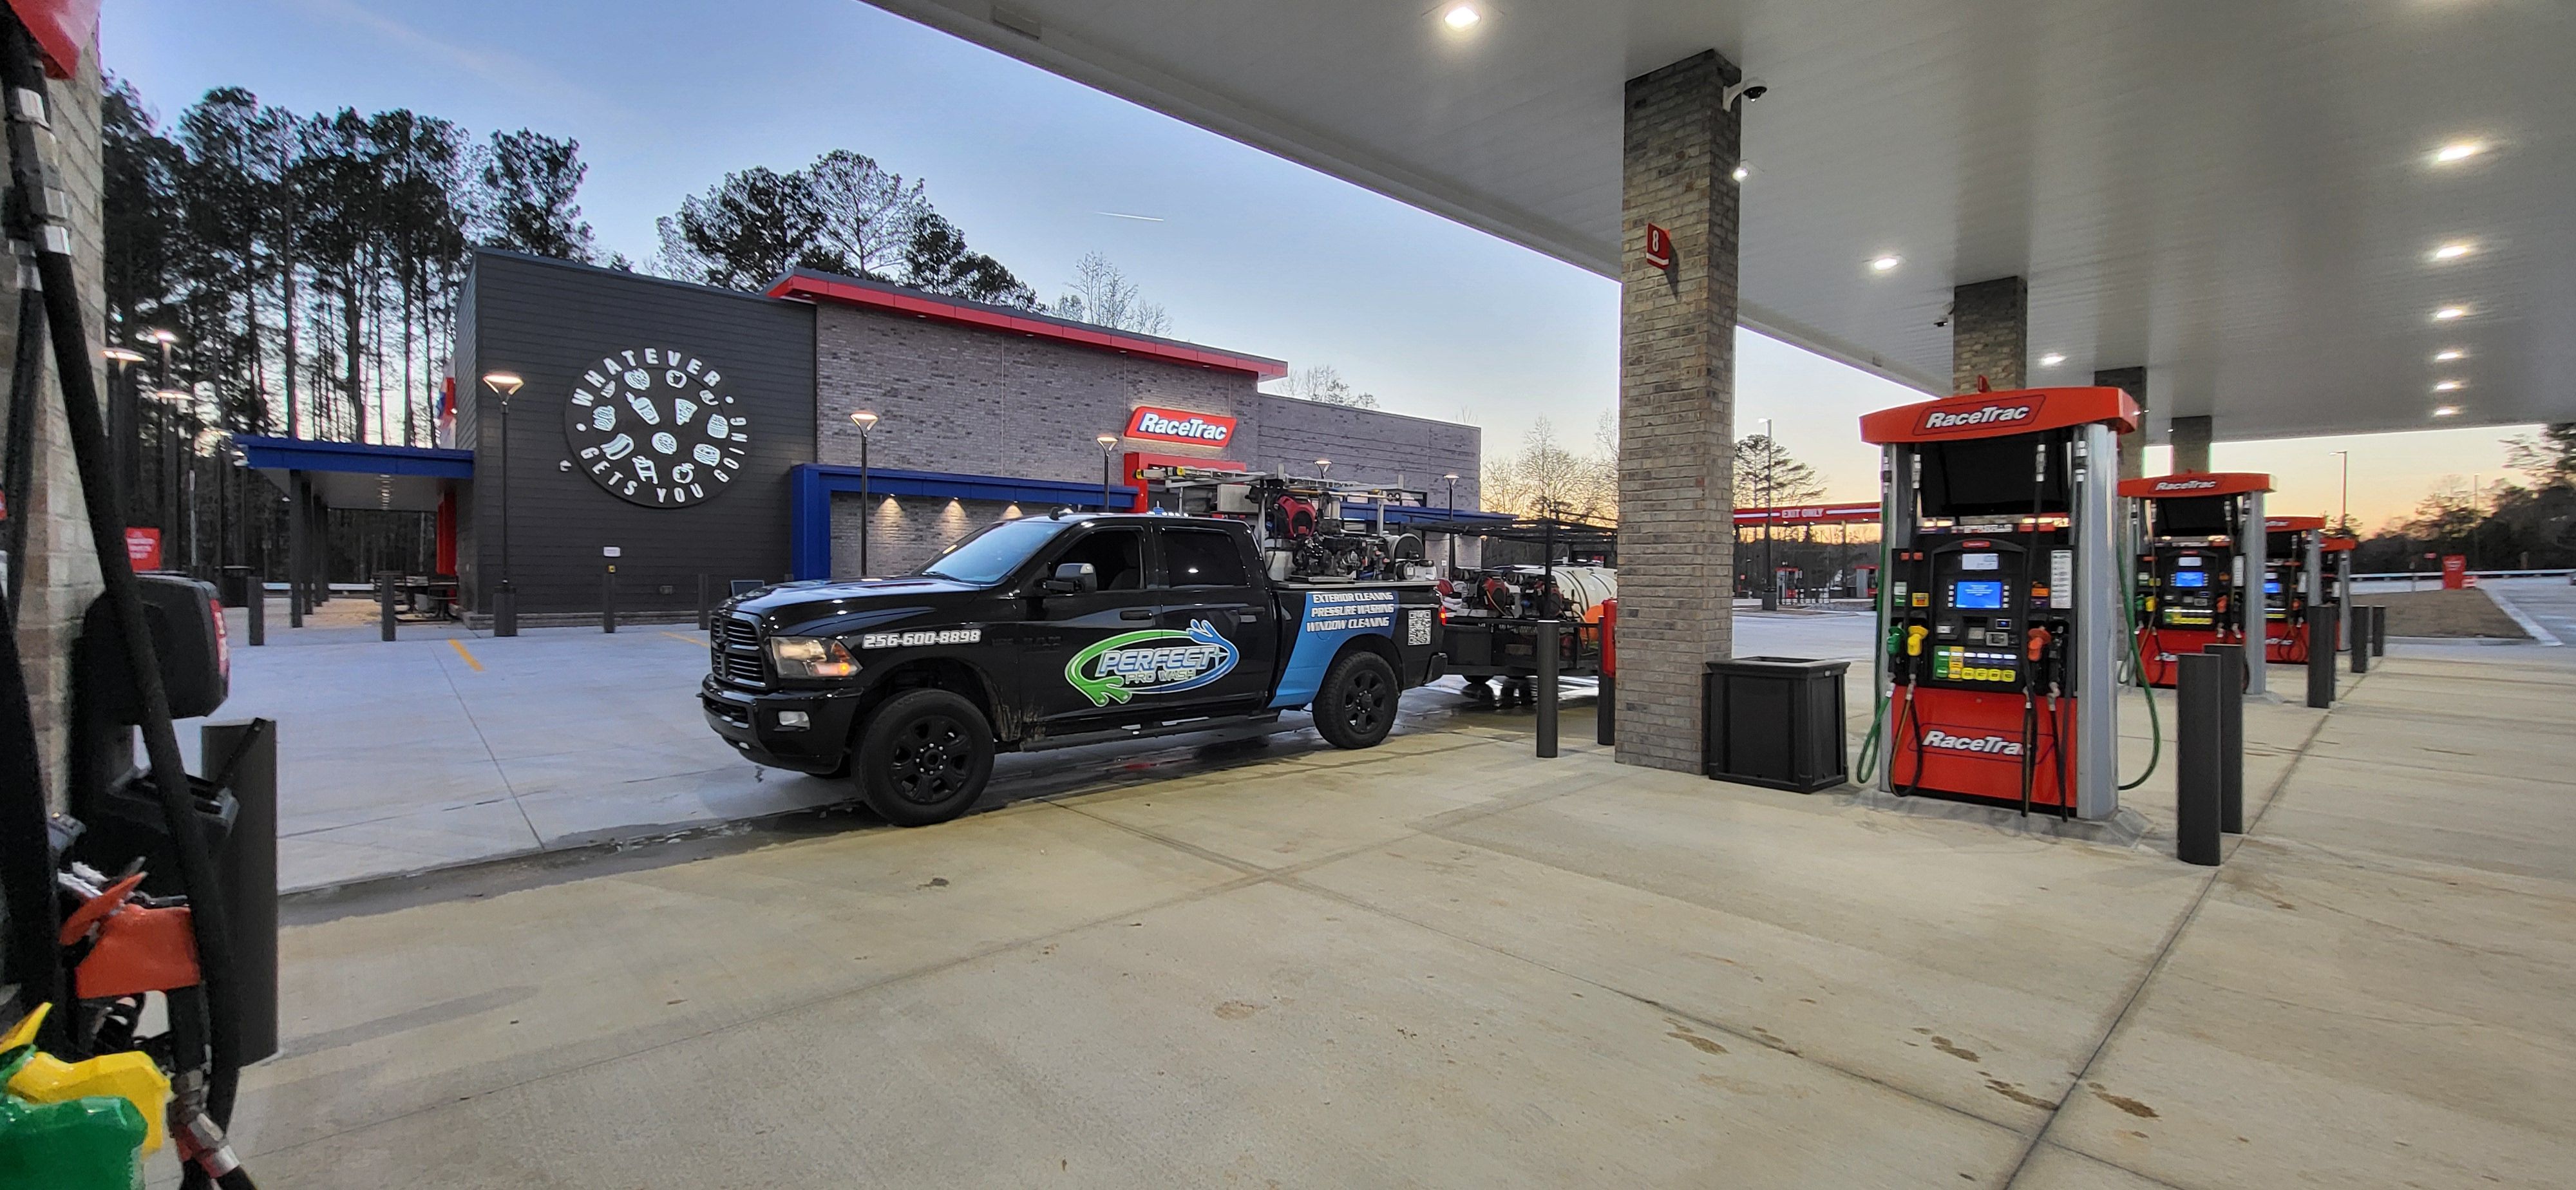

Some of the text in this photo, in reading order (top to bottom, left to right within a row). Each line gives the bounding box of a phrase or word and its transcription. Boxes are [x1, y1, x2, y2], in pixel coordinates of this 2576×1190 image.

[1652, 229, 1660, 252] 8
[571, 348, 721, 407] WHATEVER
[1138, 412, 1227, 441] RaceTrac
[1925, 406, 2030, 429] RaceTrac
[580, 417, 748, 503] GETS YOU GOING
[2155, 480, 2217, 491] RaceTrac
[1312, 592, 1394, 603] EXTERIOR CLEANING
[1311, 603, 1395, 618] PRESSURE WASHING
[1306, 617, 1390, 632] WINDOW CLEANING
[862, 629, 981, 649] 256-600-8898
[1095, 646, 1216, 677] PERFECT
[1125, 668, 1197, 684] PRO WASH
